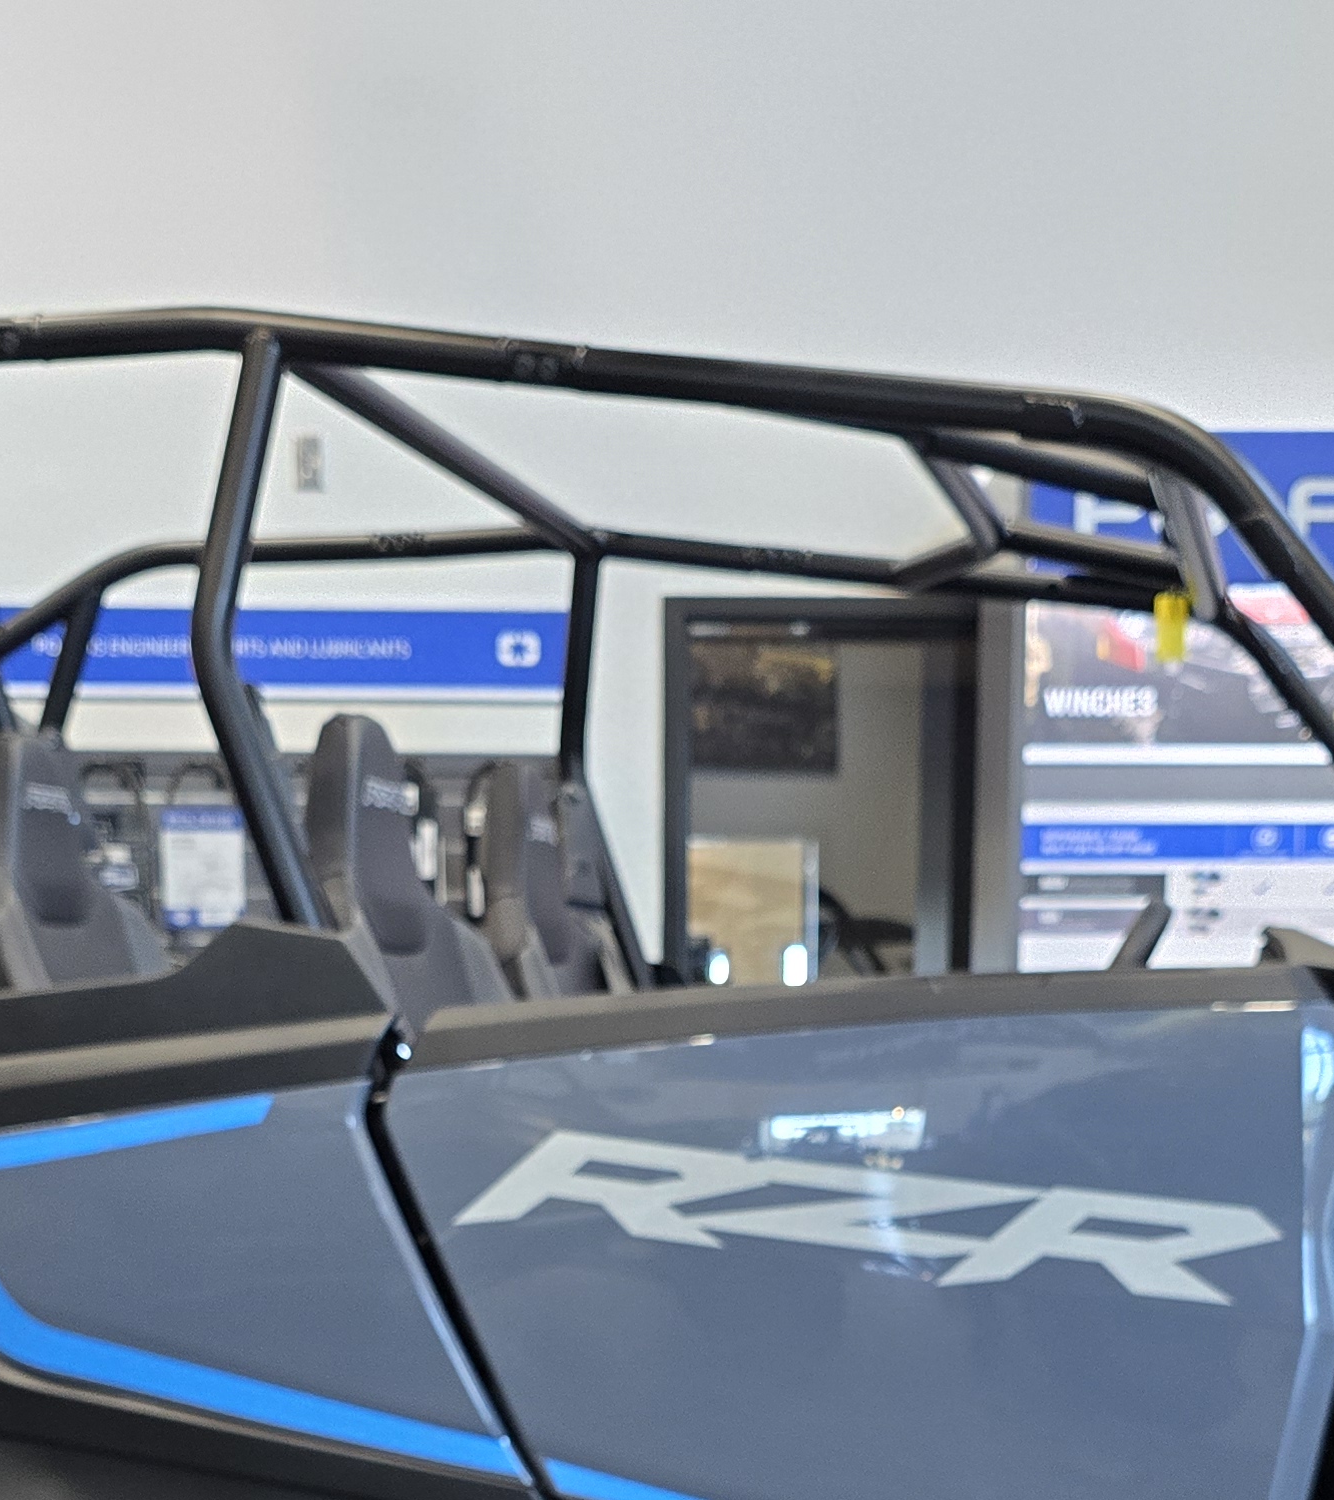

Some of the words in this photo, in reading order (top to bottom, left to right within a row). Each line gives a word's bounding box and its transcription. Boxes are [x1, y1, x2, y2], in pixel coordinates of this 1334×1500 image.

[269, 635, 309, 660] AND
[1044, 685, 1158, 718] WINCHES
[451, 1129, 1283, 1307] RZR
